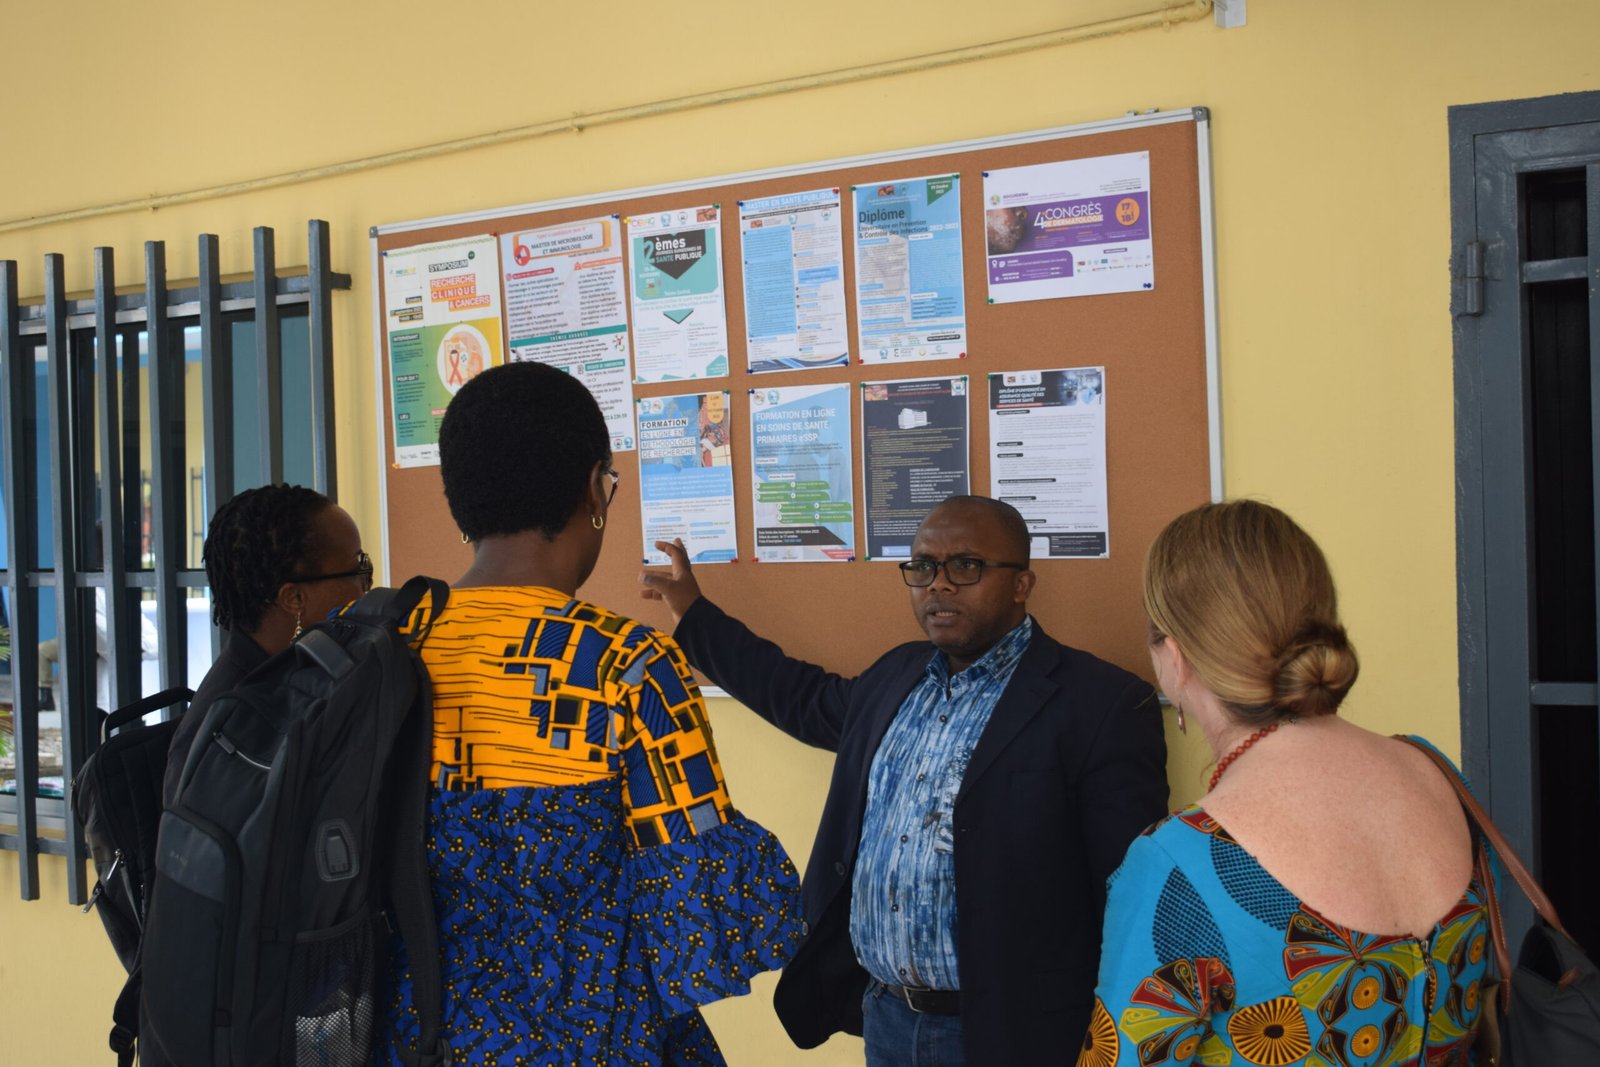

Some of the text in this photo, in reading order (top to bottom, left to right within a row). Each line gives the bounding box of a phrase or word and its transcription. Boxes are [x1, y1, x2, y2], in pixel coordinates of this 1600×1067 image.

[859, 208, 905, 224] Diplôme
[1045, 201, 1102, 220] CONGRÈS
[899, 219, 927, 228] Prévention
[1053, 214, 1104, 227] DERMATOLOGIE
[864, 229, 888, 239] Contrôle
[889, 228, 899, 236] des
[643, 237, 686, 264] 2 èmes
[674, 251, 702, 261] PUBLIQUE
[429, 259, 469, 273] SYMPOSIUM
[431, 274, 476, 288] RECHERCHE
[431, 286, 476, 299] CLINIQUE
[456, 295, 491, 308] CANCERS
[756, 408, 836, 420] FORMATION EN LIGNE
[641, 419, 687, 429] FORMATION
[756, 424, 766, 433] EN
[767, 422, 791, 432] SOINS
[792, 422, 802, 431] DE
[757, 434, 798, 444] PRIMAIRES
[653, 447, 695, 457] RECHERCHE
